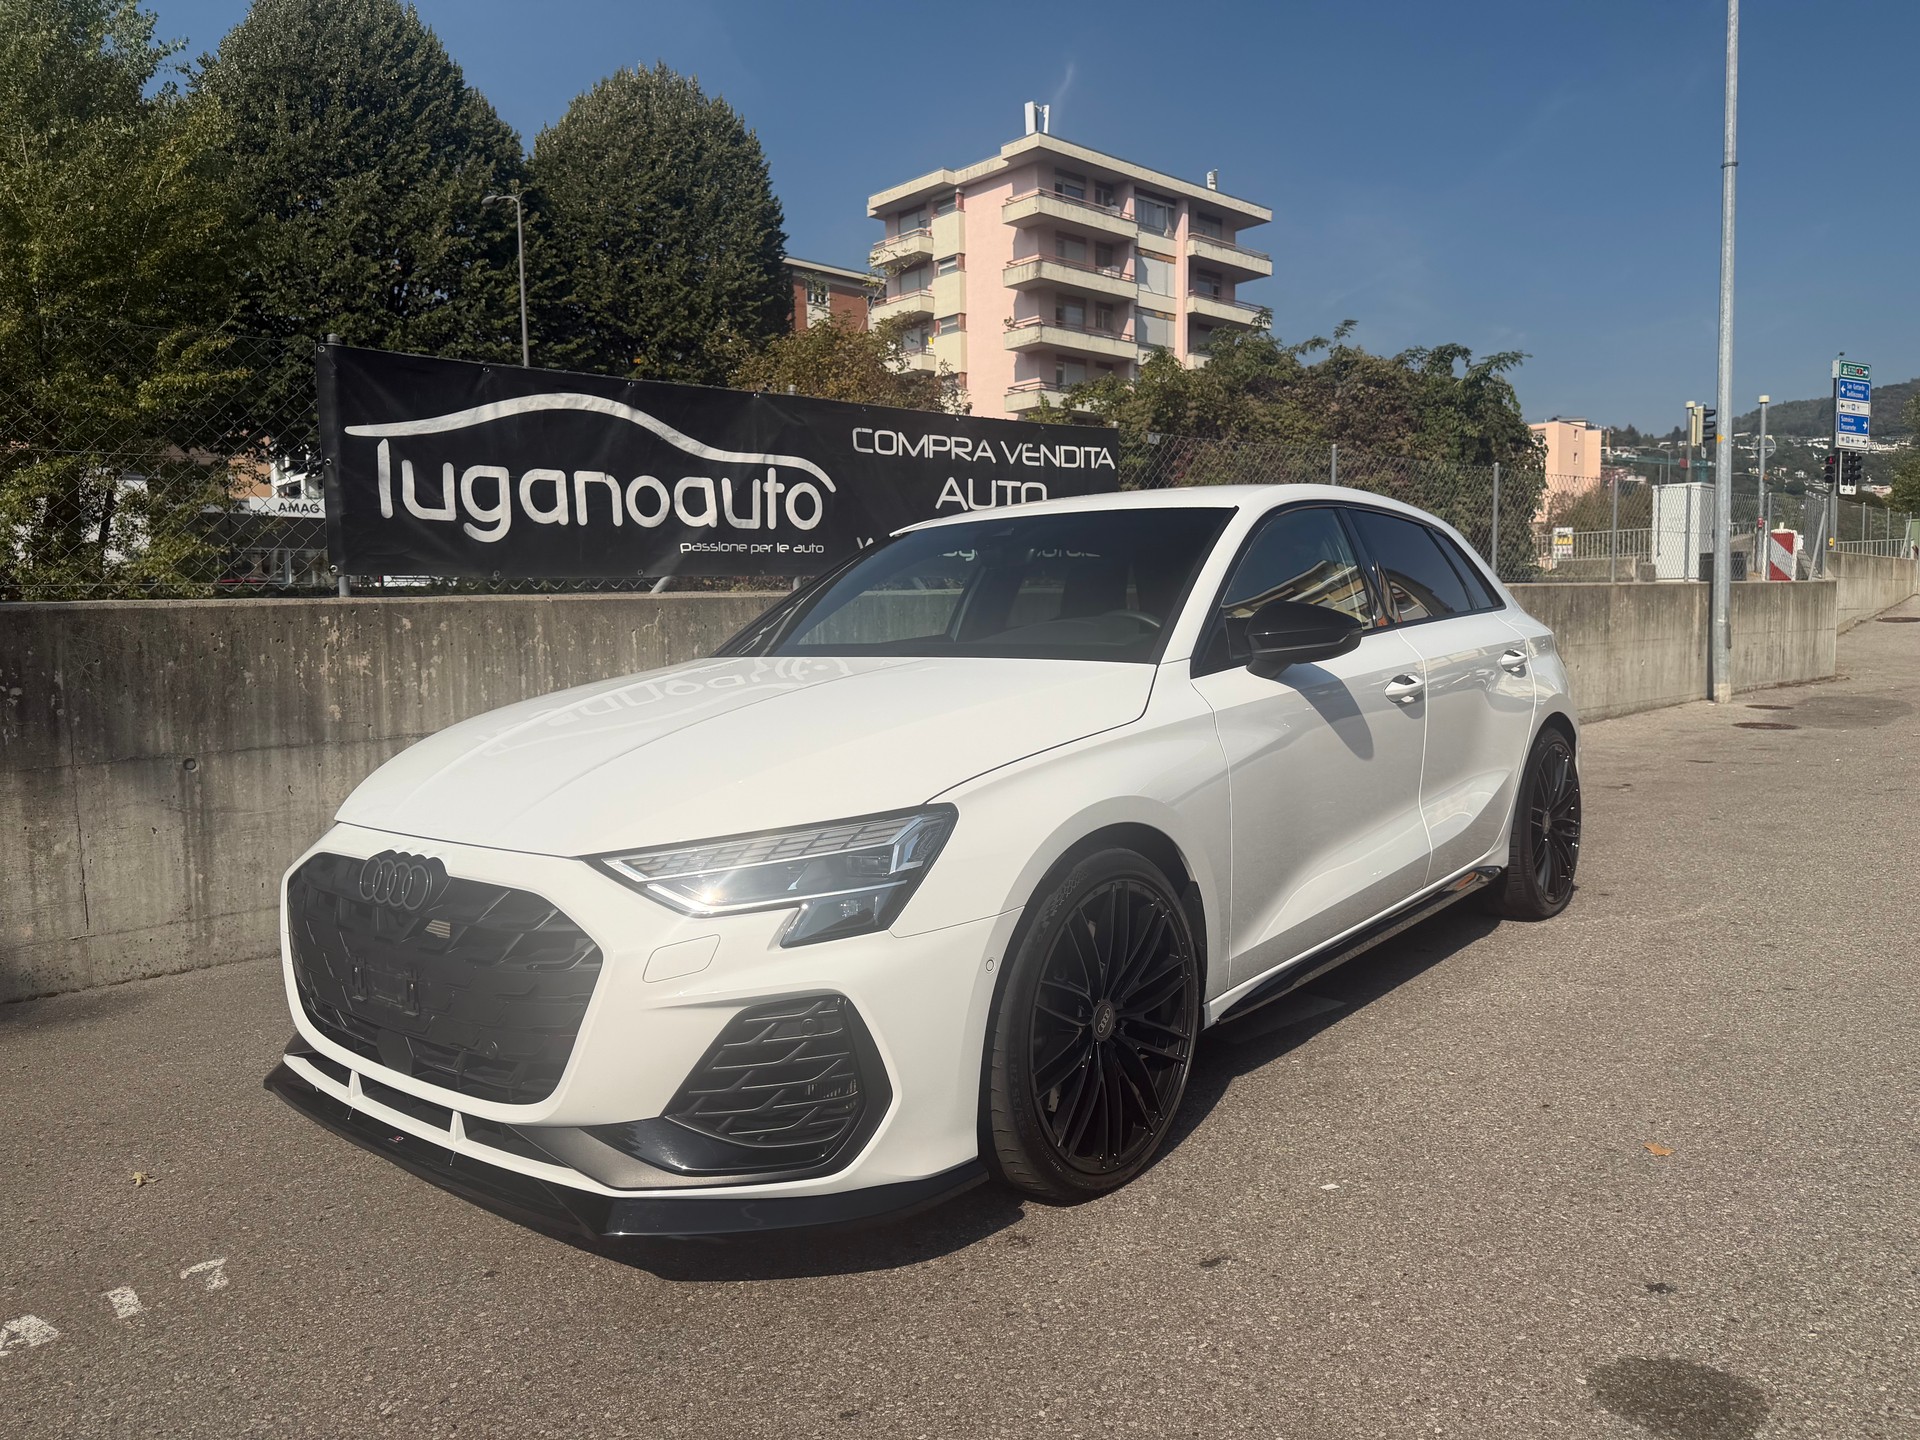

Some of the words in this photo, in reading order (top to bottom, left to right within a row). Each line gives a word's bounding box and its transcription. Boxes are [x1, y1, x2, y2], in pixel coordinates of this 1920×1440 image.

[852, 427, 997, 465] COMPRA
[1000, 440, 1116, 470] VENDITA
[377, 438, 823, 542] luganoauto
[935, 476, 1048, 511] AUTO
[277, 502, 320, 514] AMAG
[680, 541, 748, 554] passione
[750, 543, 774, 554] per
[776, 542, 790, 553] le
[793, 543, 825, 554] auto
